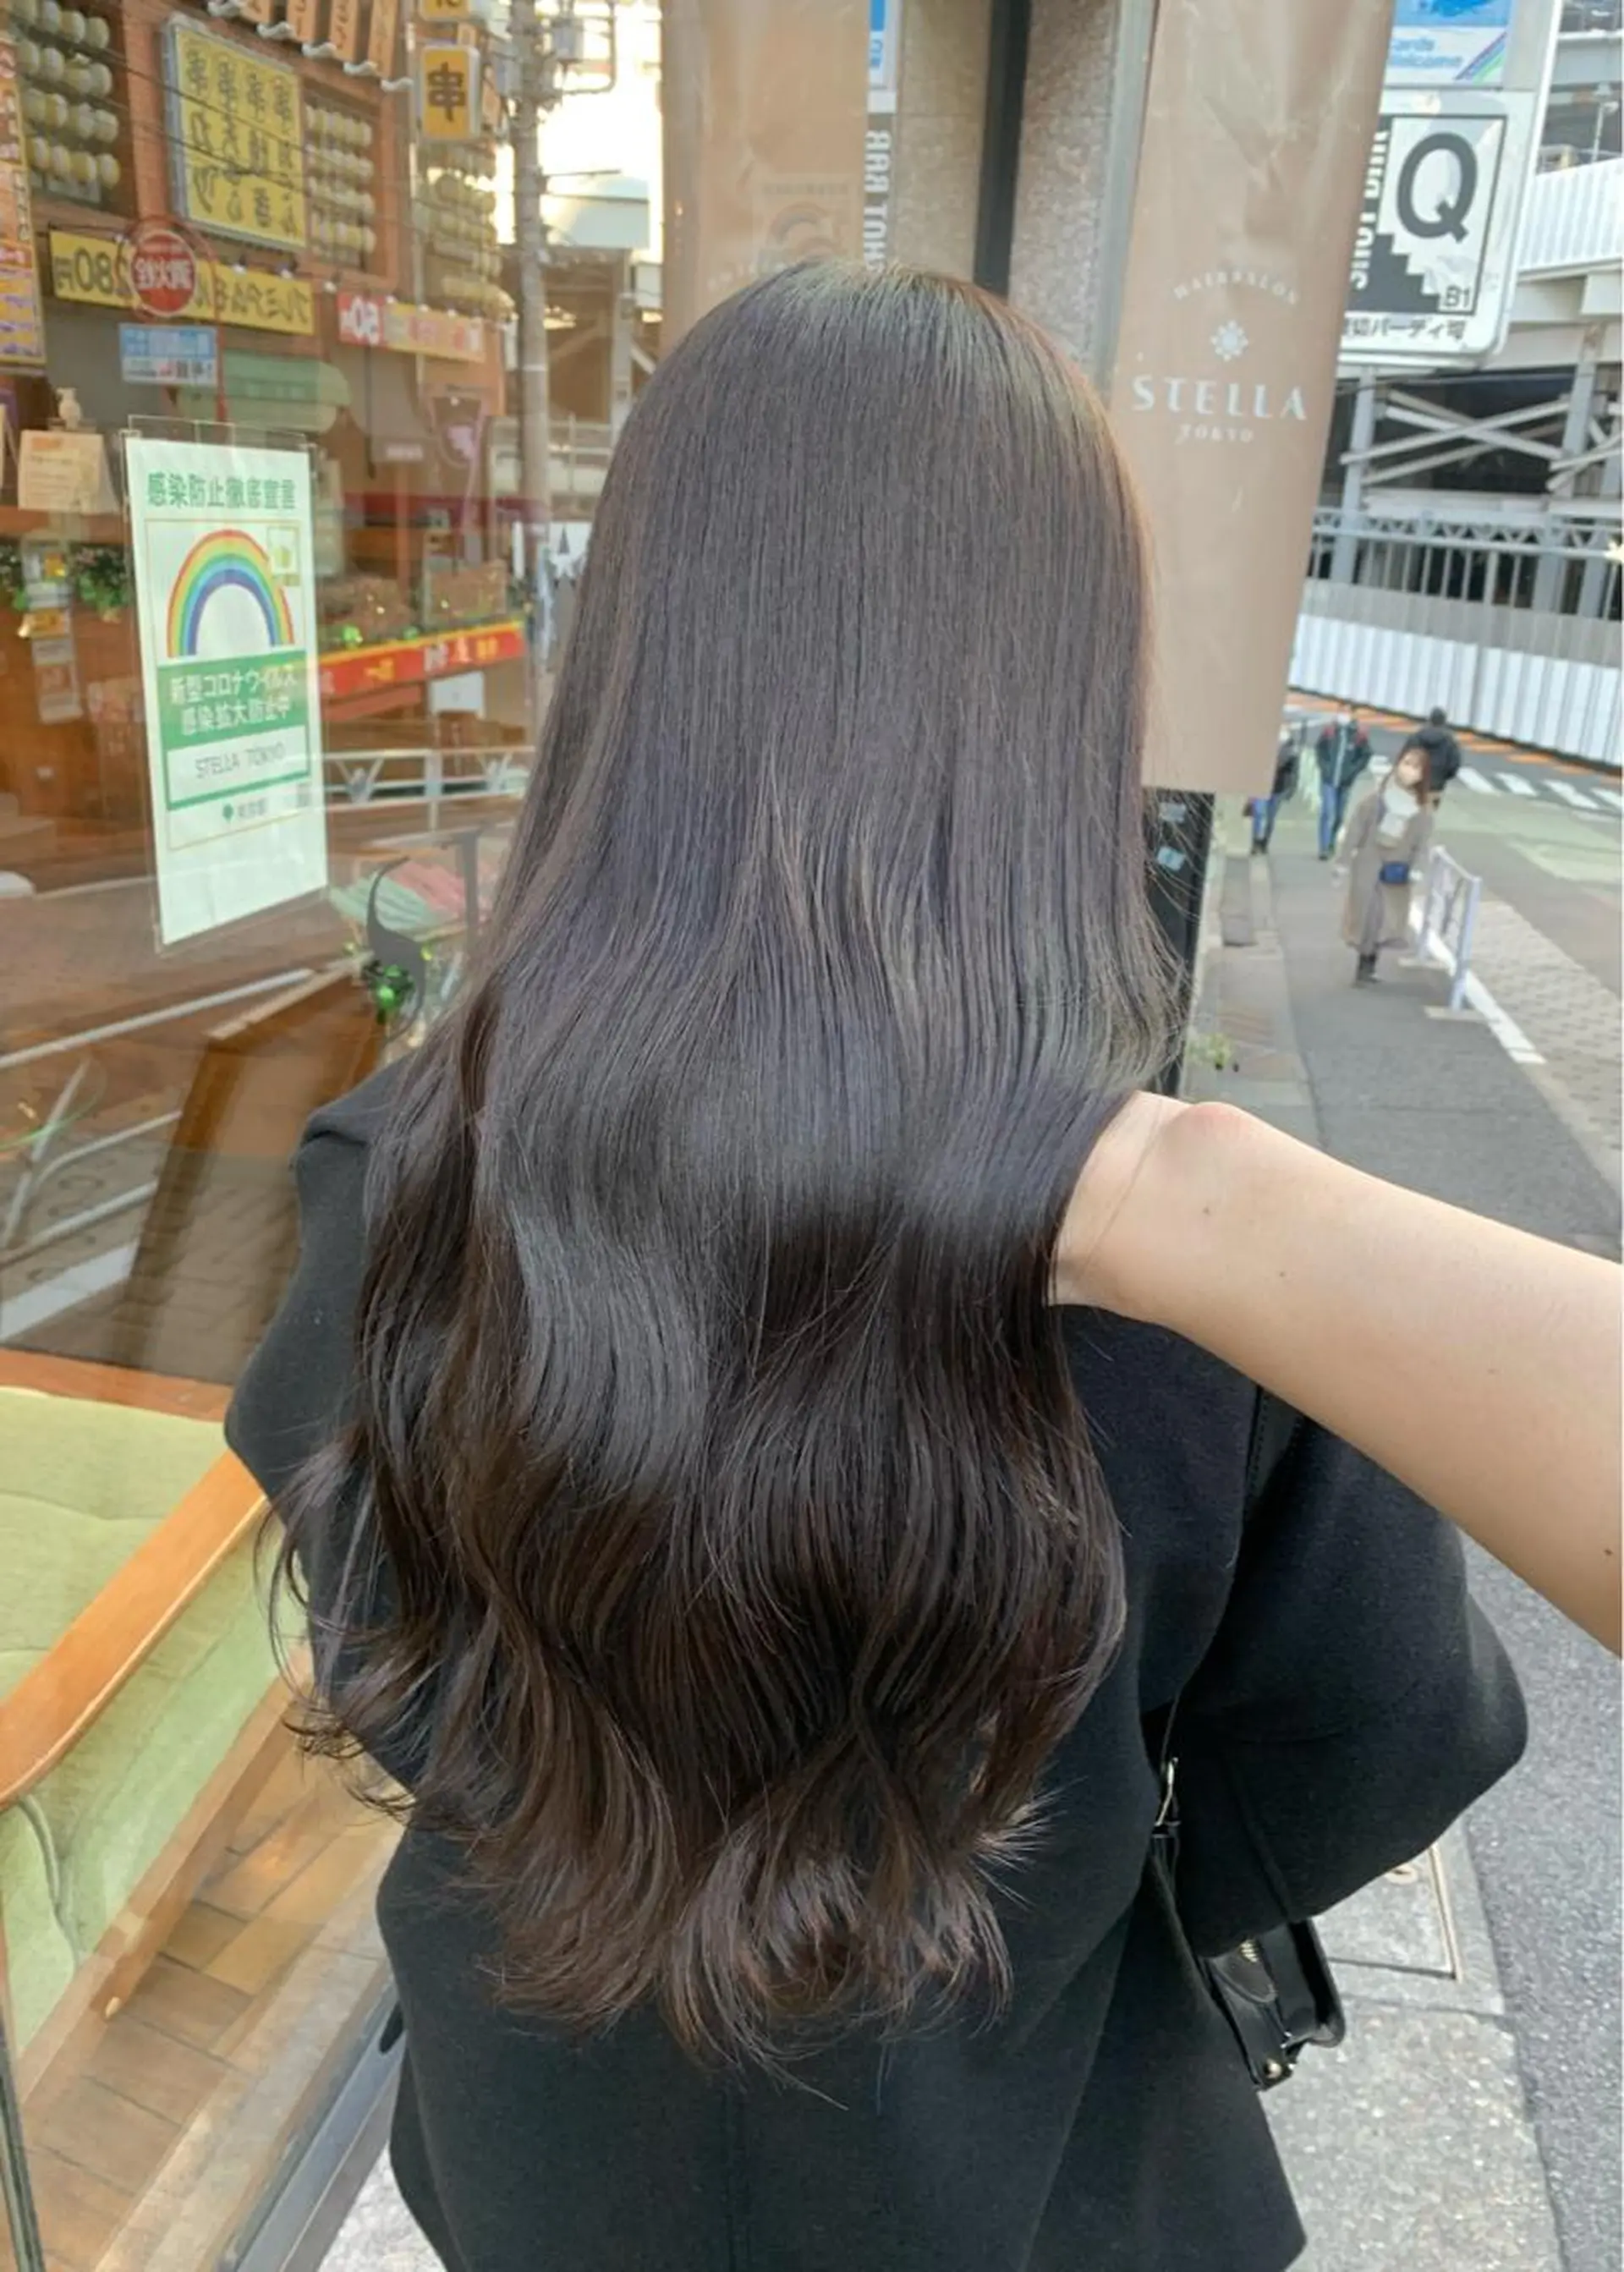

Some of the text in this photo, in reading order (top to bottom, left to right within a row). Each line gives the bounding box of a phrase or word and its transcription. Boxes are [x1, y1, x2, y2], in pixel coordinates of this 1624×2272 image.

[1396, 132, 1478, 244] Q
[1442, 284, 1470, 309] B1
[1132, 374, 1307, 420] STELLA
[1175, 424, 1254, 445] TOKYO
